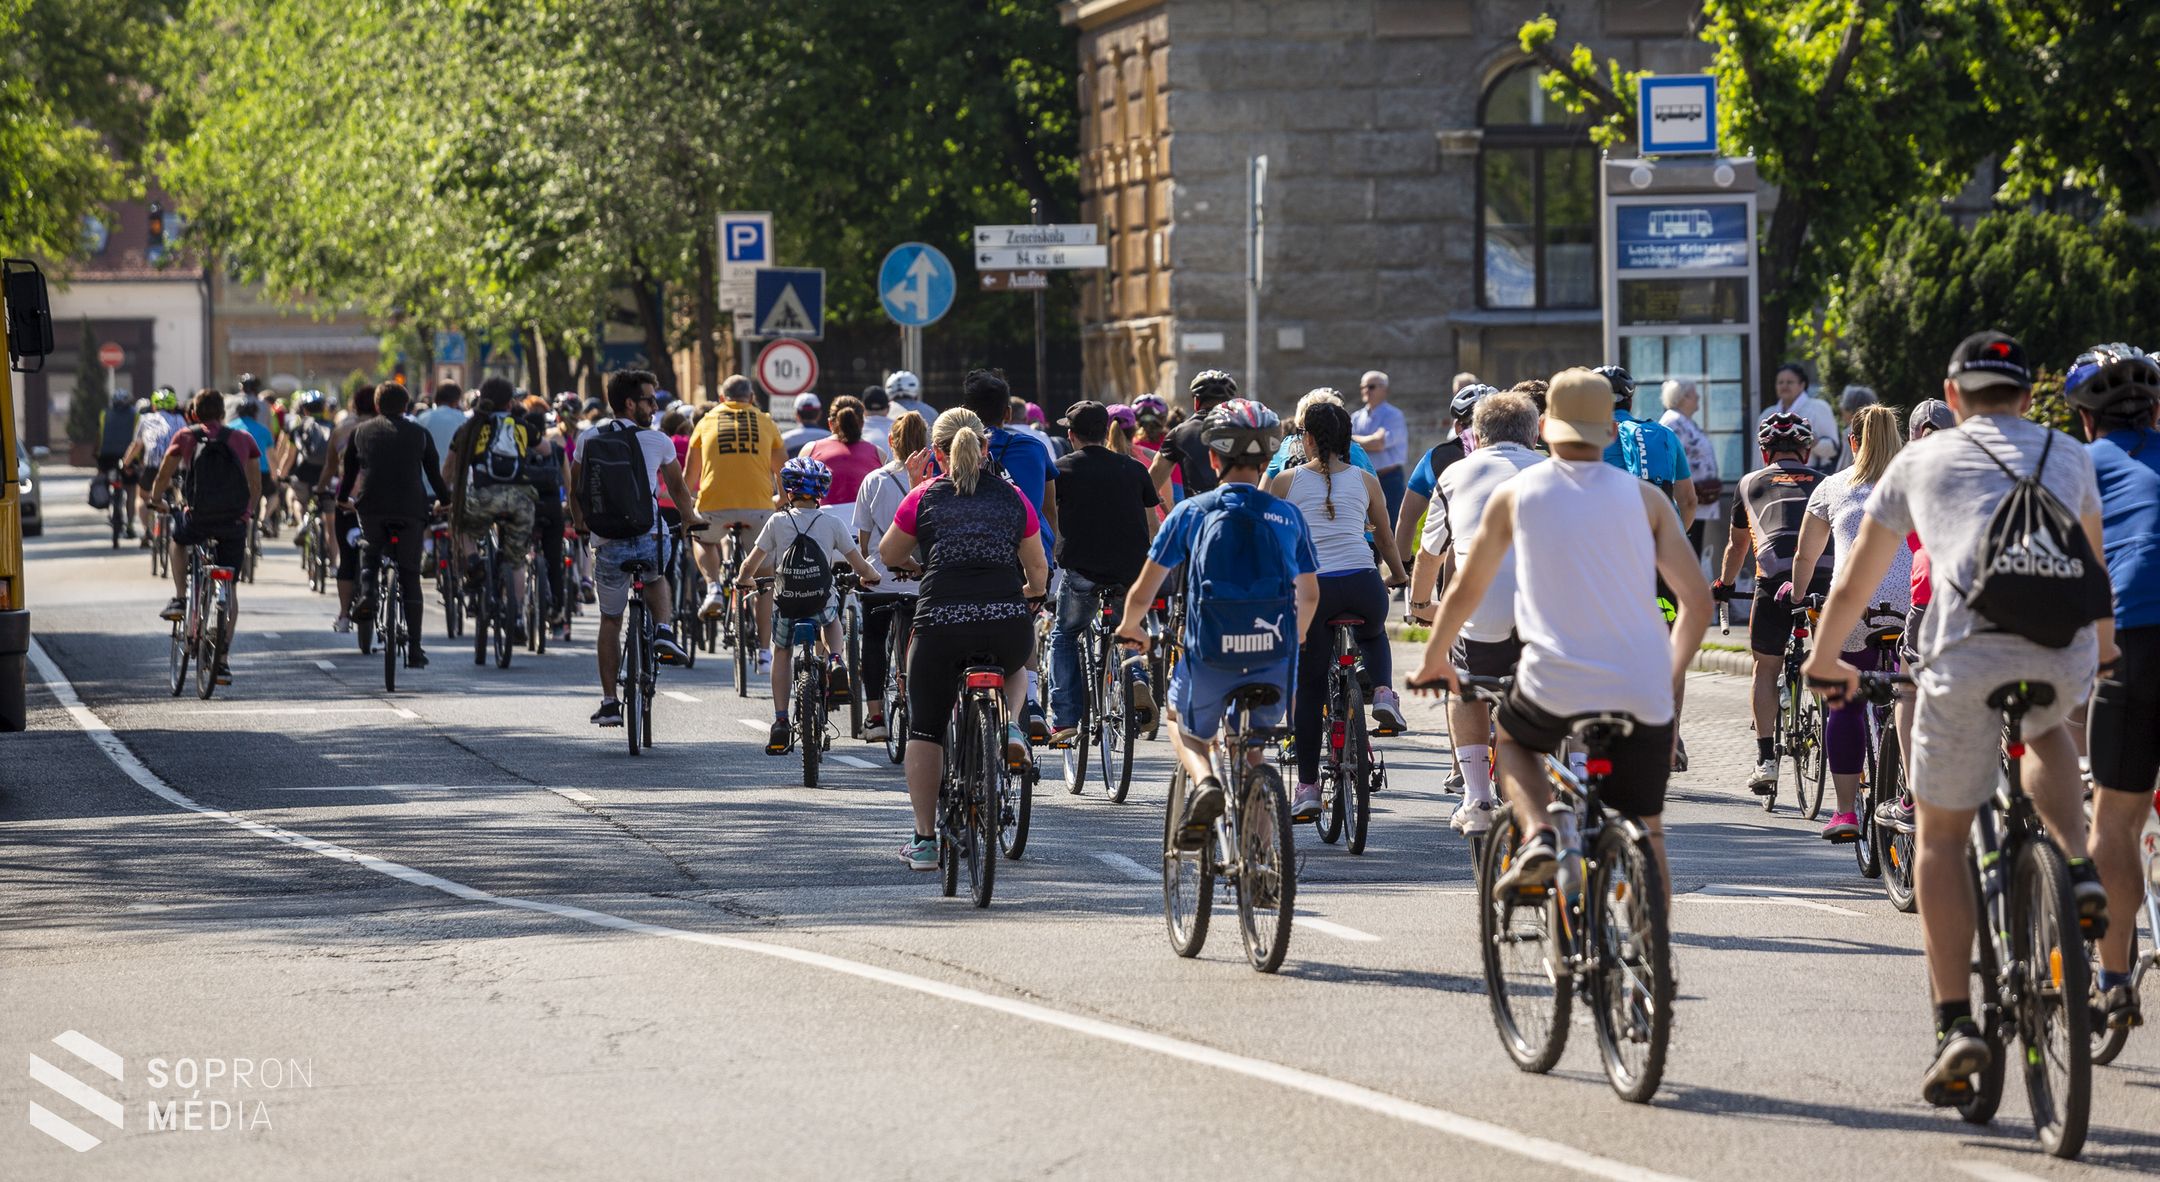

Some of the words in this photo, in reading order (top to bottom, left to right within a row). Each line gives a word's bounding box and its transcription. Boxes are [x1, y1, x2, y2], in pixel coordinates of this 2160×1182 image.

[732, 224, 758, 259] P
[774, 359, 792, 379] 10
[1995, 552, 2085, 578] adidas
[1221, 632, 1274, 653] PUMA
